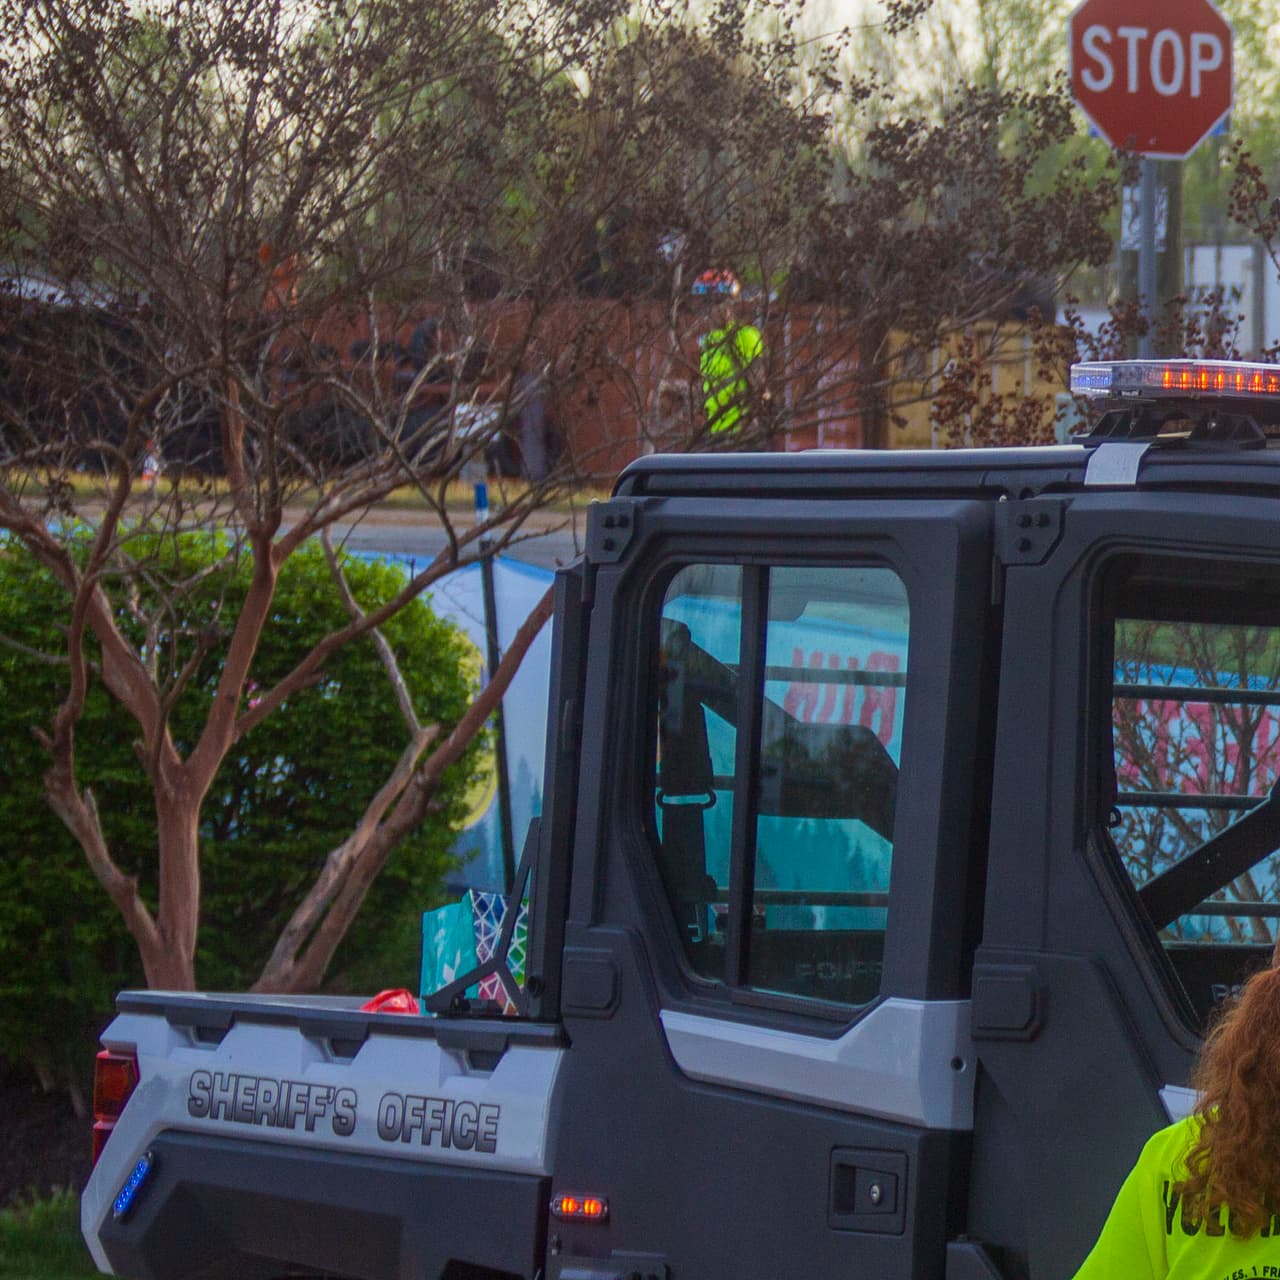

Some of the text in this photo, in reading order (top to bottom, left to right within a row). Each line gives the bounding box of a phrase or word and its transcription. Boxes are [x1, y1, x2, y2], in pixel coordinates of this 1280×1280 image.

[1081, 24, 1224, 97] STOP
[188, 1070, 500, 1153] SHERIFF'S OFFICE
[1252, 1266, 1257, 1277] 1
